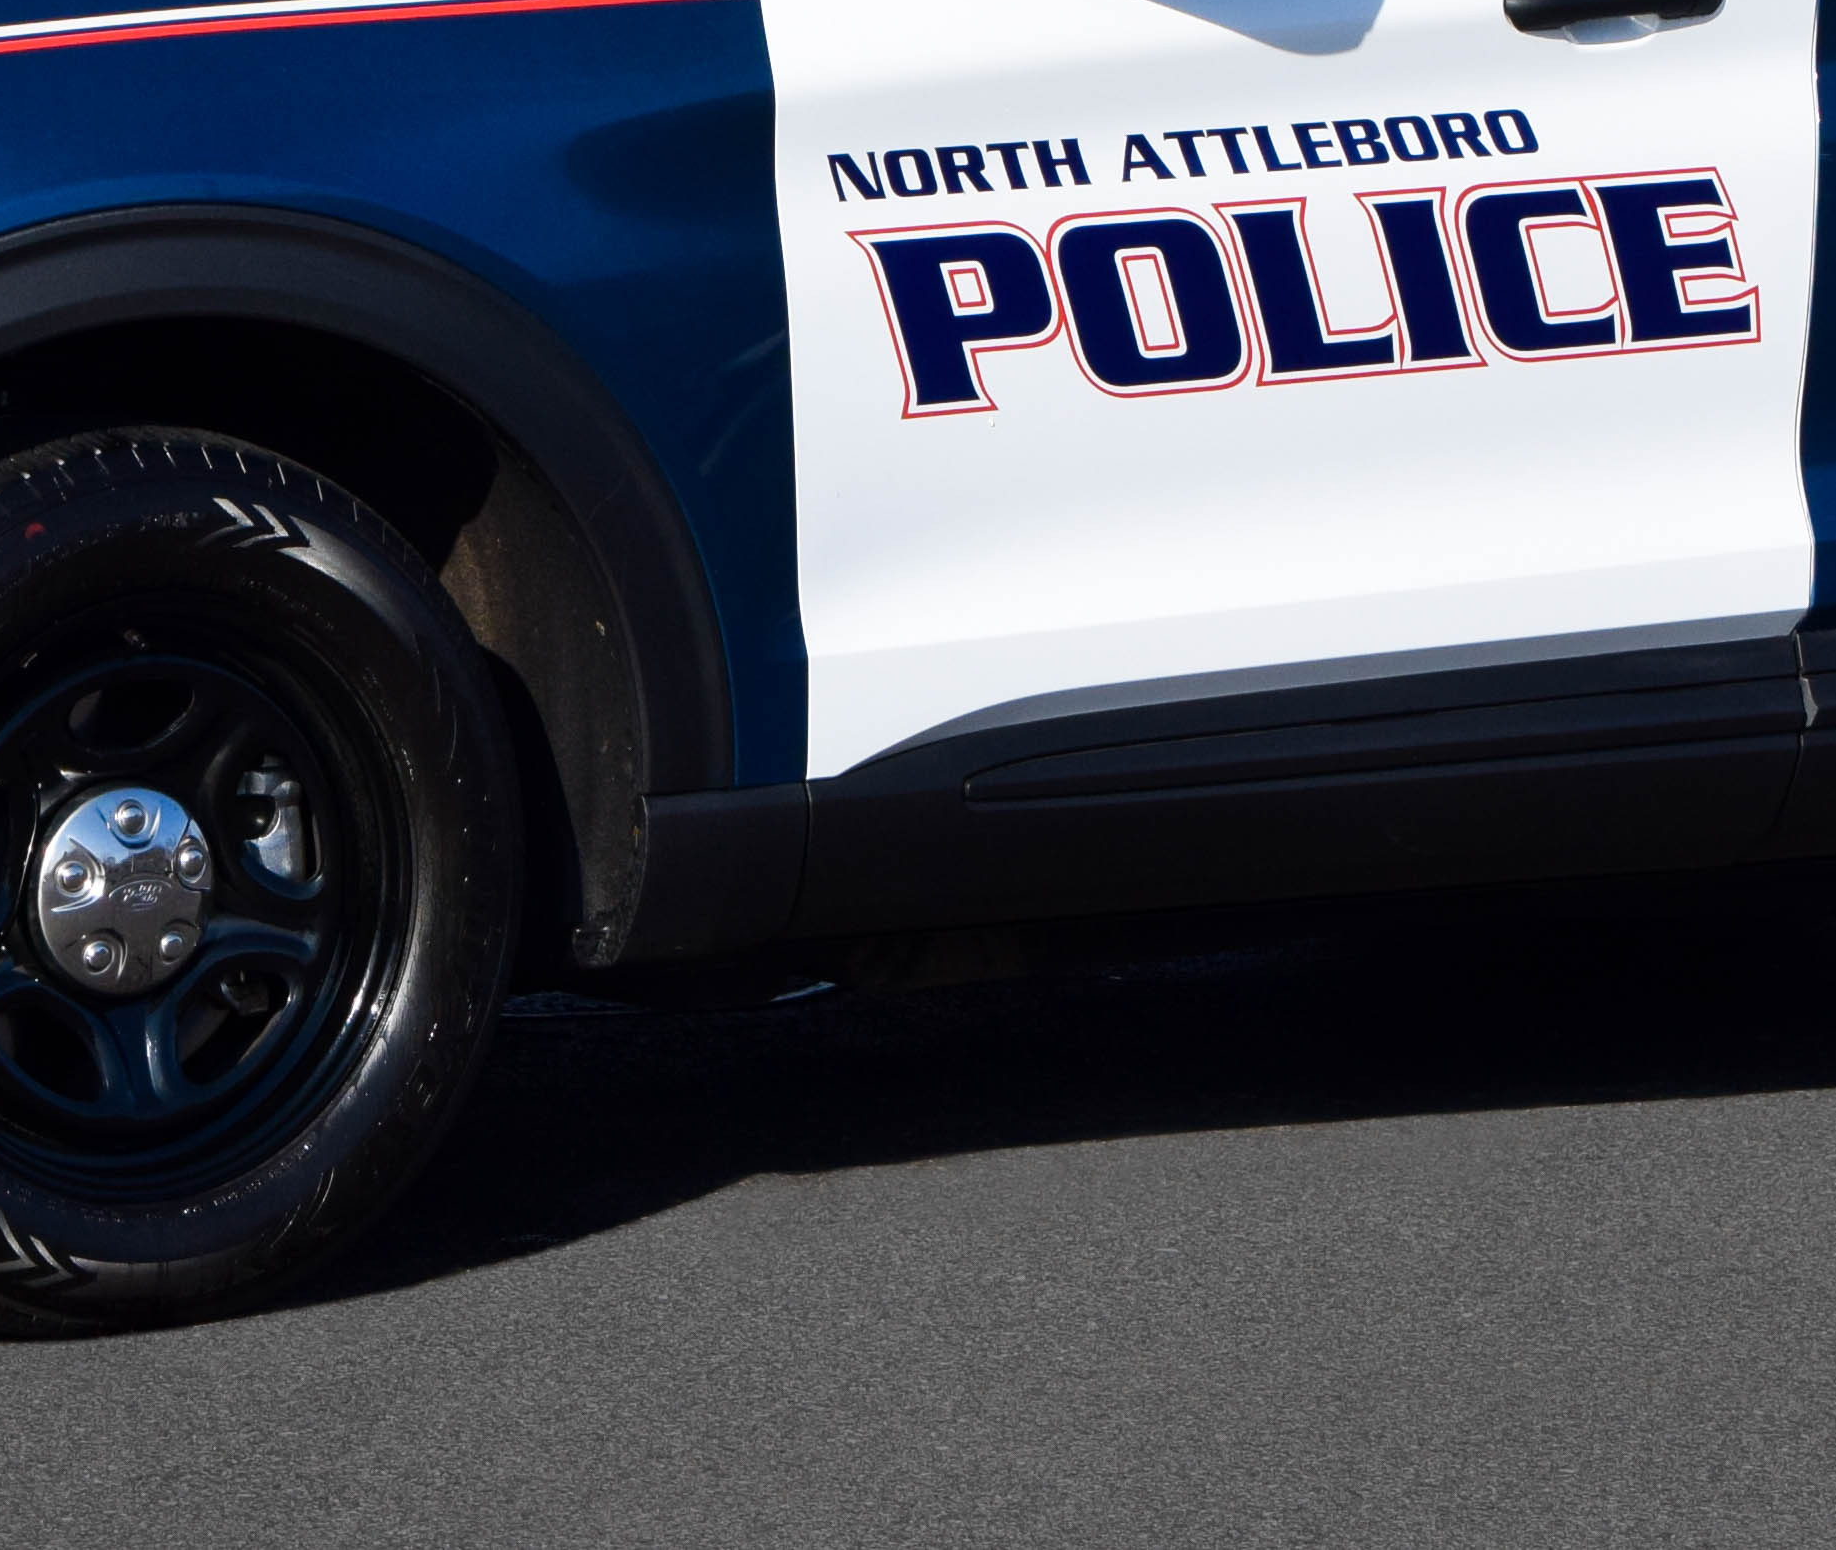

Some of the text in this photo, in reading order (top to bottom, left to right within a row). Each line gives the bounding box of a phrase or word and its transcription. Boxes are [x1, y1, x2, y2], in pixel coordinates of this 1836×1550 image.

[827, 109, 1539, 202] NORTH ATTLEBORO
[846, 166, 1763, 421] POLICE
